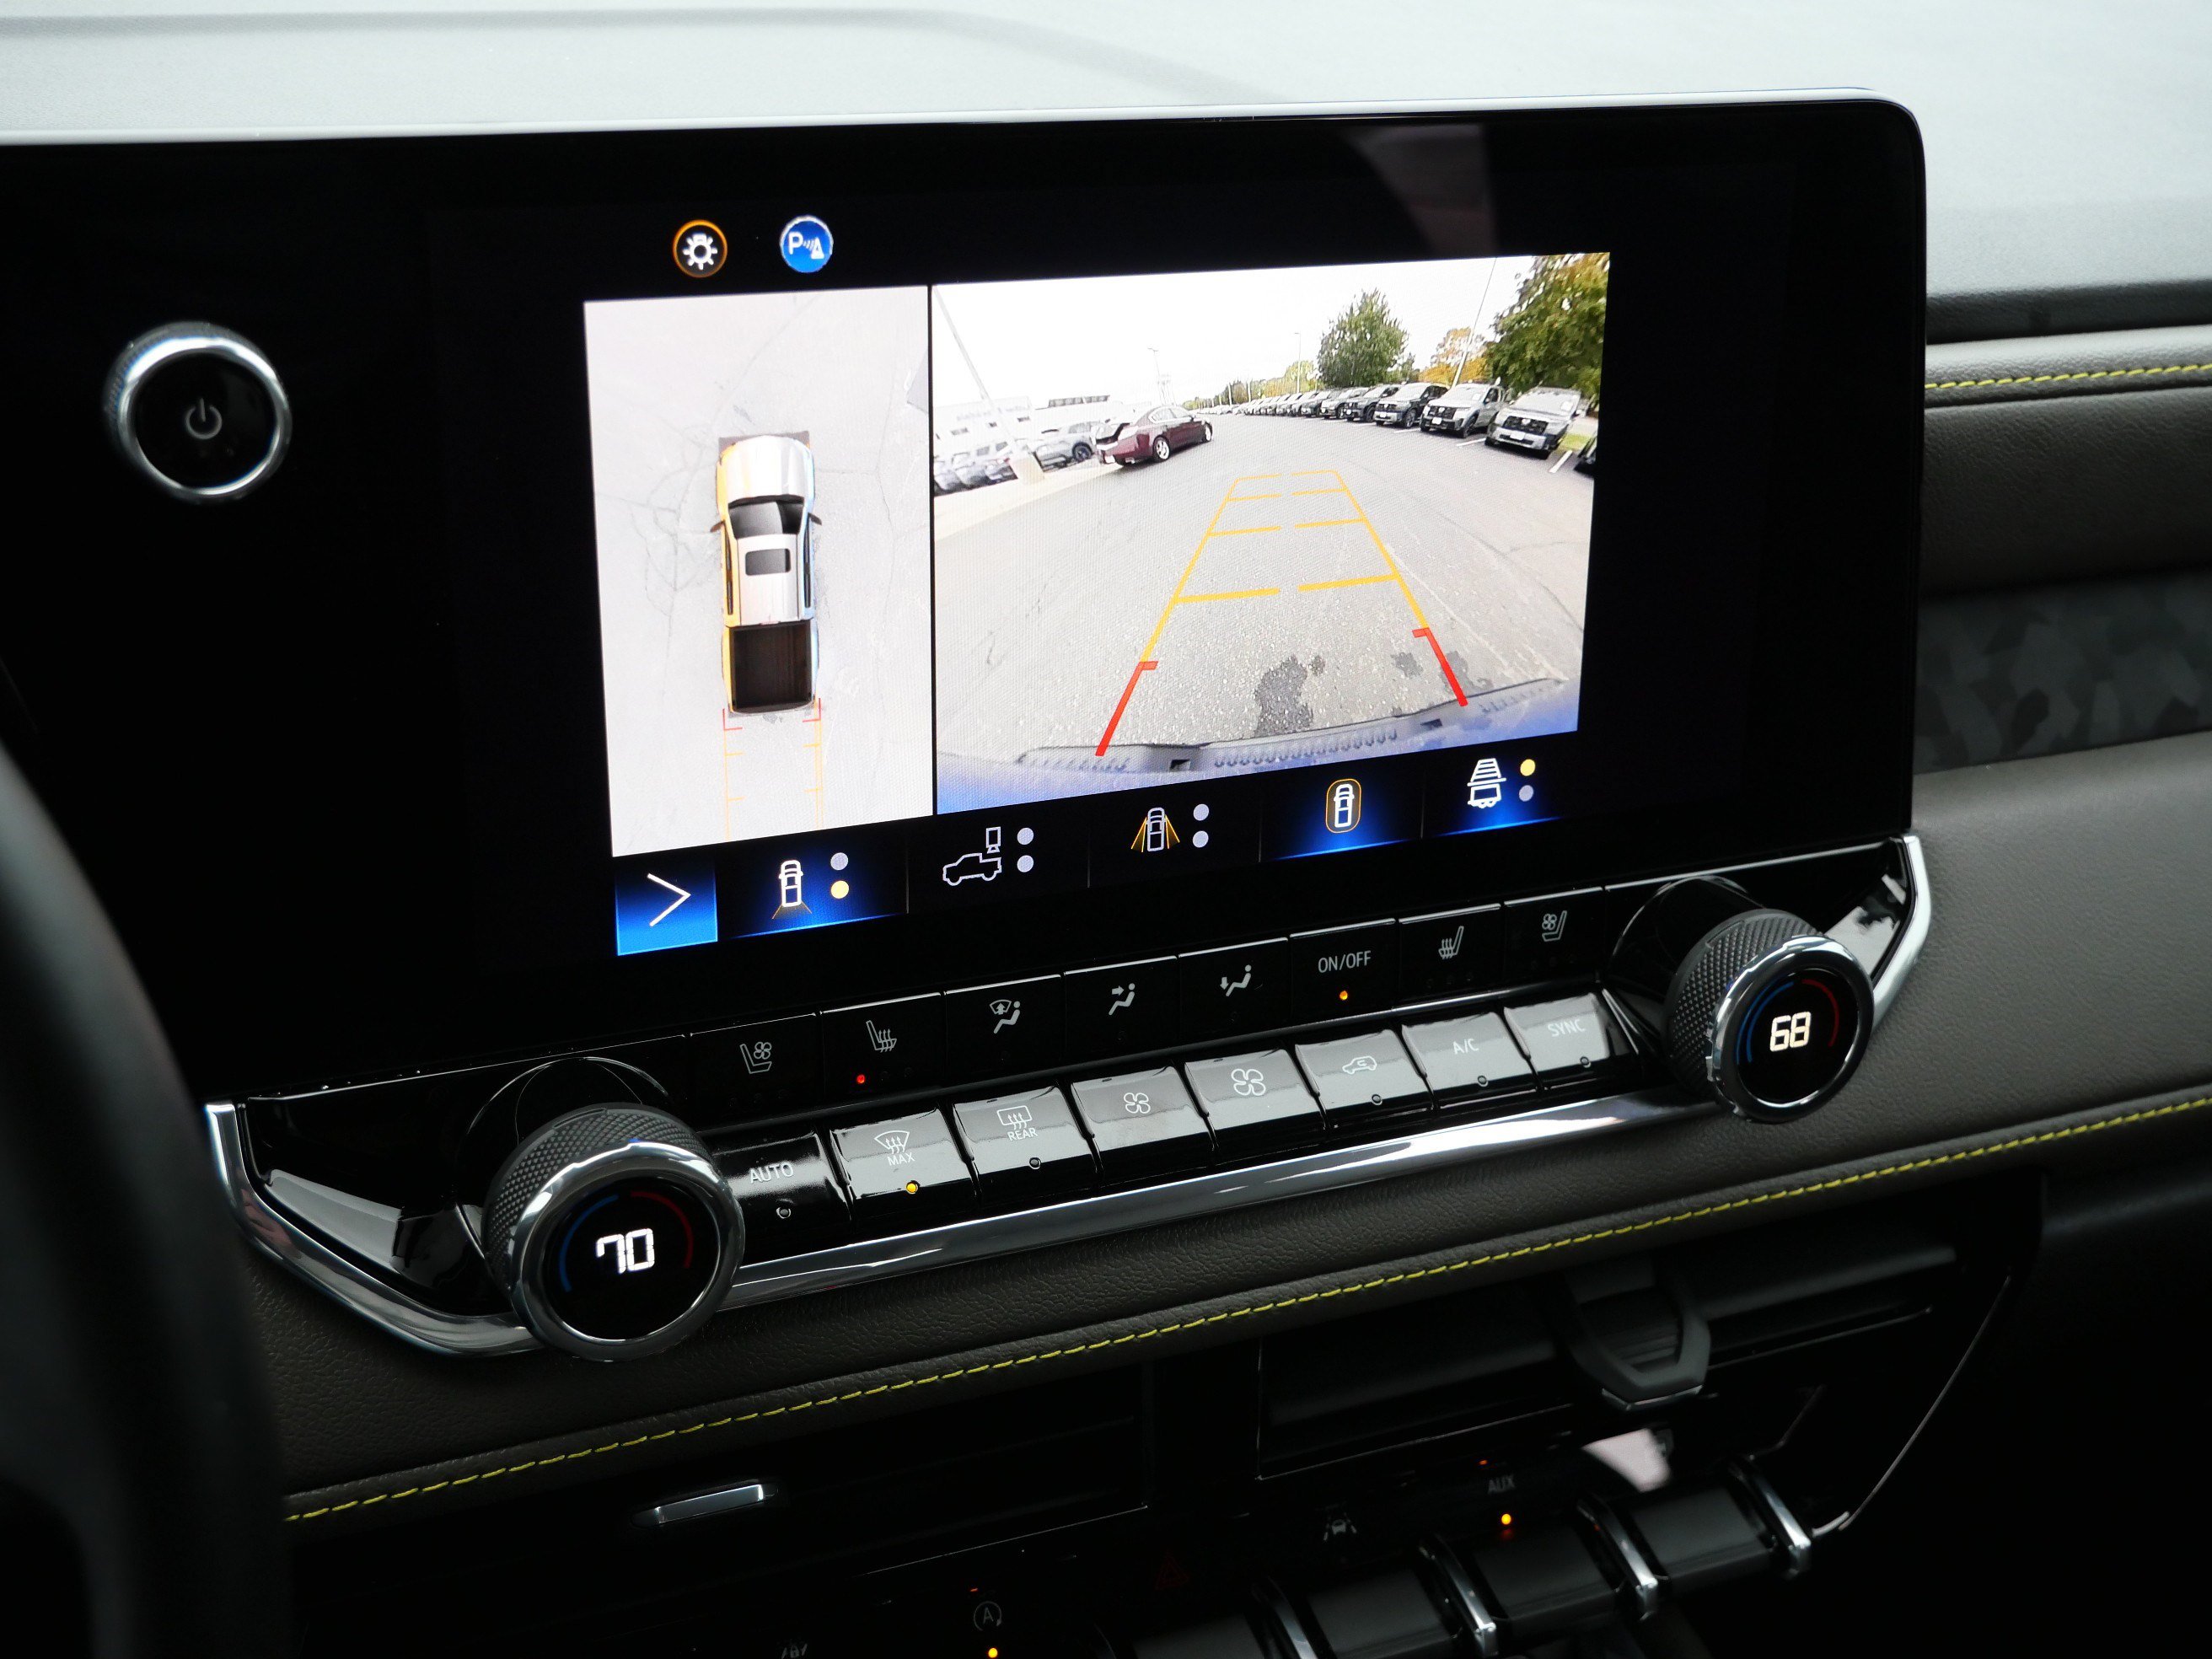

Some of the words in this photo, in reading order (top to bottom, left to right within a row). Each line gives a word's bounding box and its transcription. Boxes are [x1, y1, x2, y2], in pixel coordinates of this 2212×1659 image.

[788, 231, 803, 255] P
[1318, 950, 1372, 973] ON/OFF
[1548, 1019, 1587, 1037] SYNC
[1769, 1011, 1812, 1052] 68
[1452, 1038, 1479, 1055] A/C
[1007, 1127, 1039, 1141] REAR
[887, 1152, 915, 1166] MAX
[749, 1162, 794, 1184] AUTO
[596, 1227, 655, 1275] 70
[1487, 1474, 1517, 1495] AUX
[982, 1606, 994, 1625] A
